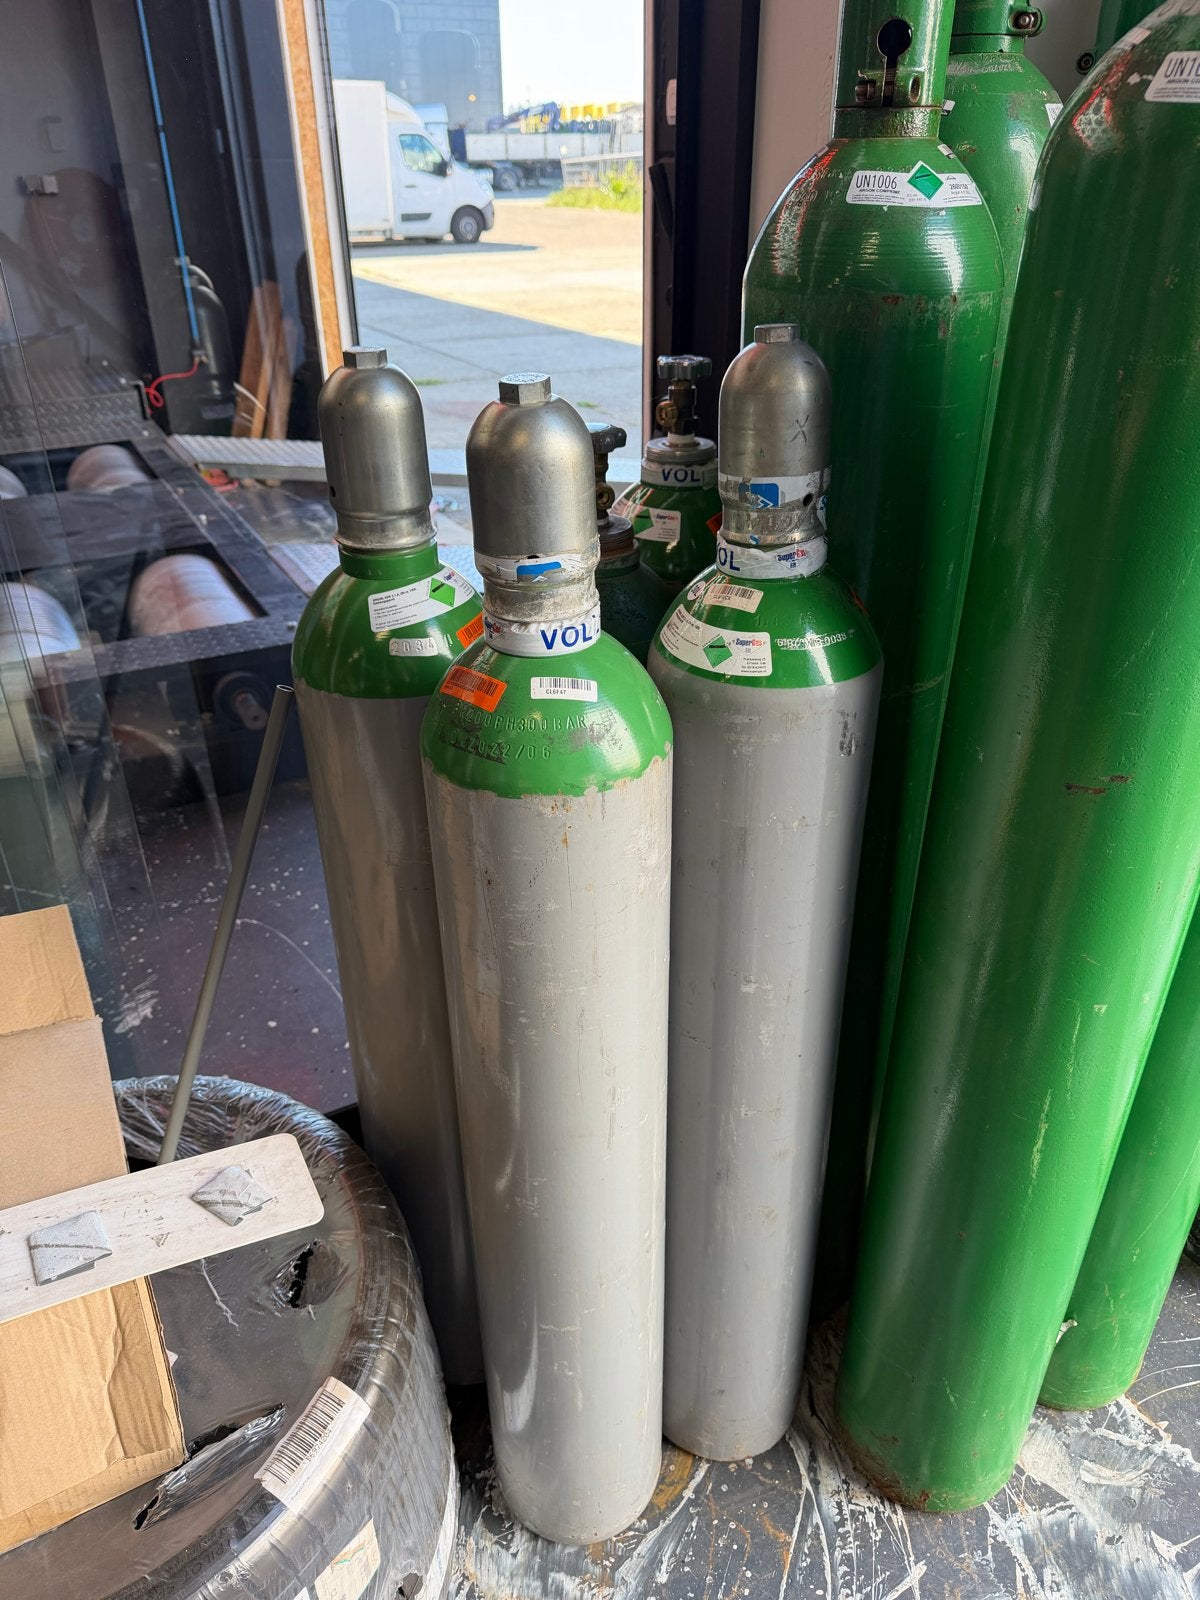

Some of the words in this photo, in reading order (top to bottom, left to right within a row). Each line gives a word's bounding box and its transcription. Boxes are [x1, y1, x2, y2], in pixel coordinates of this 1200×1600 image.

[856, 174, 897, 189] UN1006
[661, 468, 701, 482] VOL
[717, 543, 740, 571] OL
[540, 622, 593, 650] VOL
